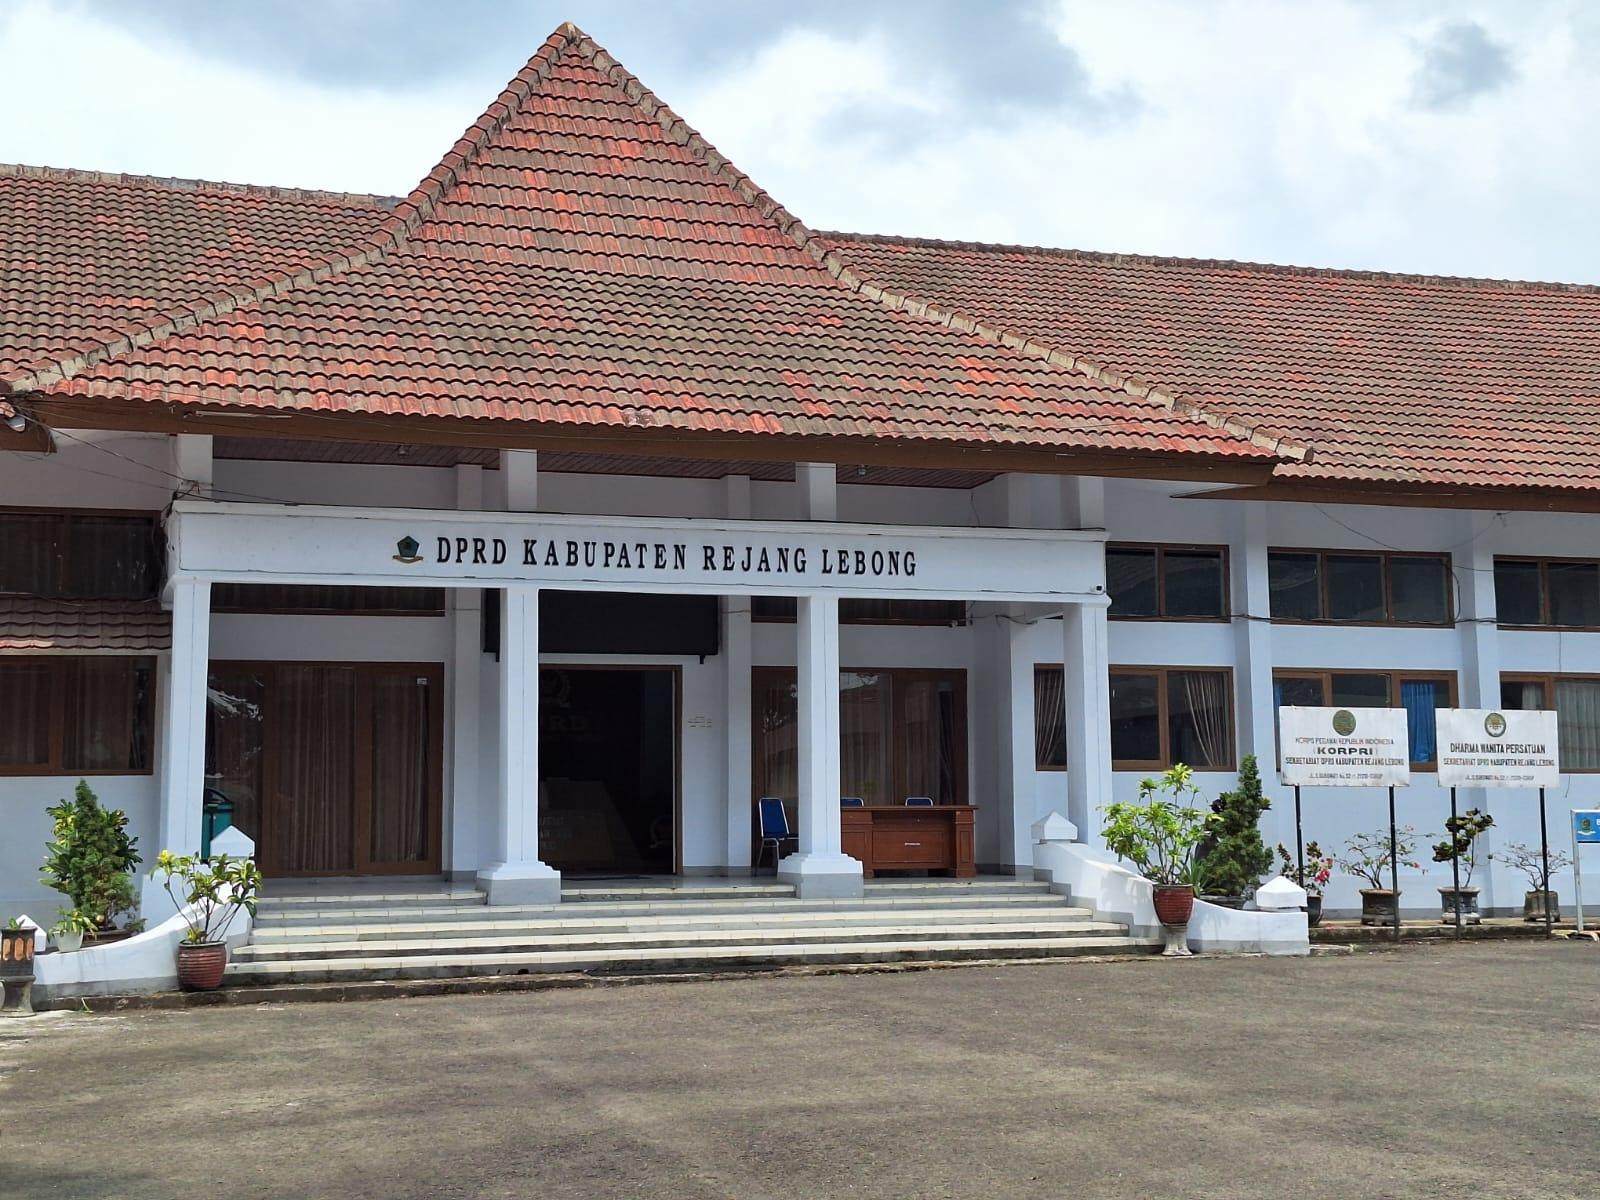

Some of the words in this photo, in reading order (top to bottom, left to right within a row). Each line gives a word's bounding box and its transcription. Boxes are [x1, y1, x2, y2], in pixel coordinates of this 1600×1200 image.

[436, 536, 507, 565] DPRD
[522, 539, 688, 571] KABUPATEN
[702, 545, 808, 574] REJANG
[821, 548, 917, 577] LEBONG
[1450, 742, 1480, 753] DHARMA
[1480, 743, 1505, 753] WANITA
[1505, 743, 1546, 754] PERSATUAN
[1335, 757, 1365, 765] KABUPATEN
[1364, 757, 1384, 766] REJANG
[1385, 758, 1404, 766] LEBONG
[1490, 758, 1517, 766] KABUPATEN
[1517, 759, 1535, 767] REJANG
[1535, 759, 1555, 767] LEBONG
